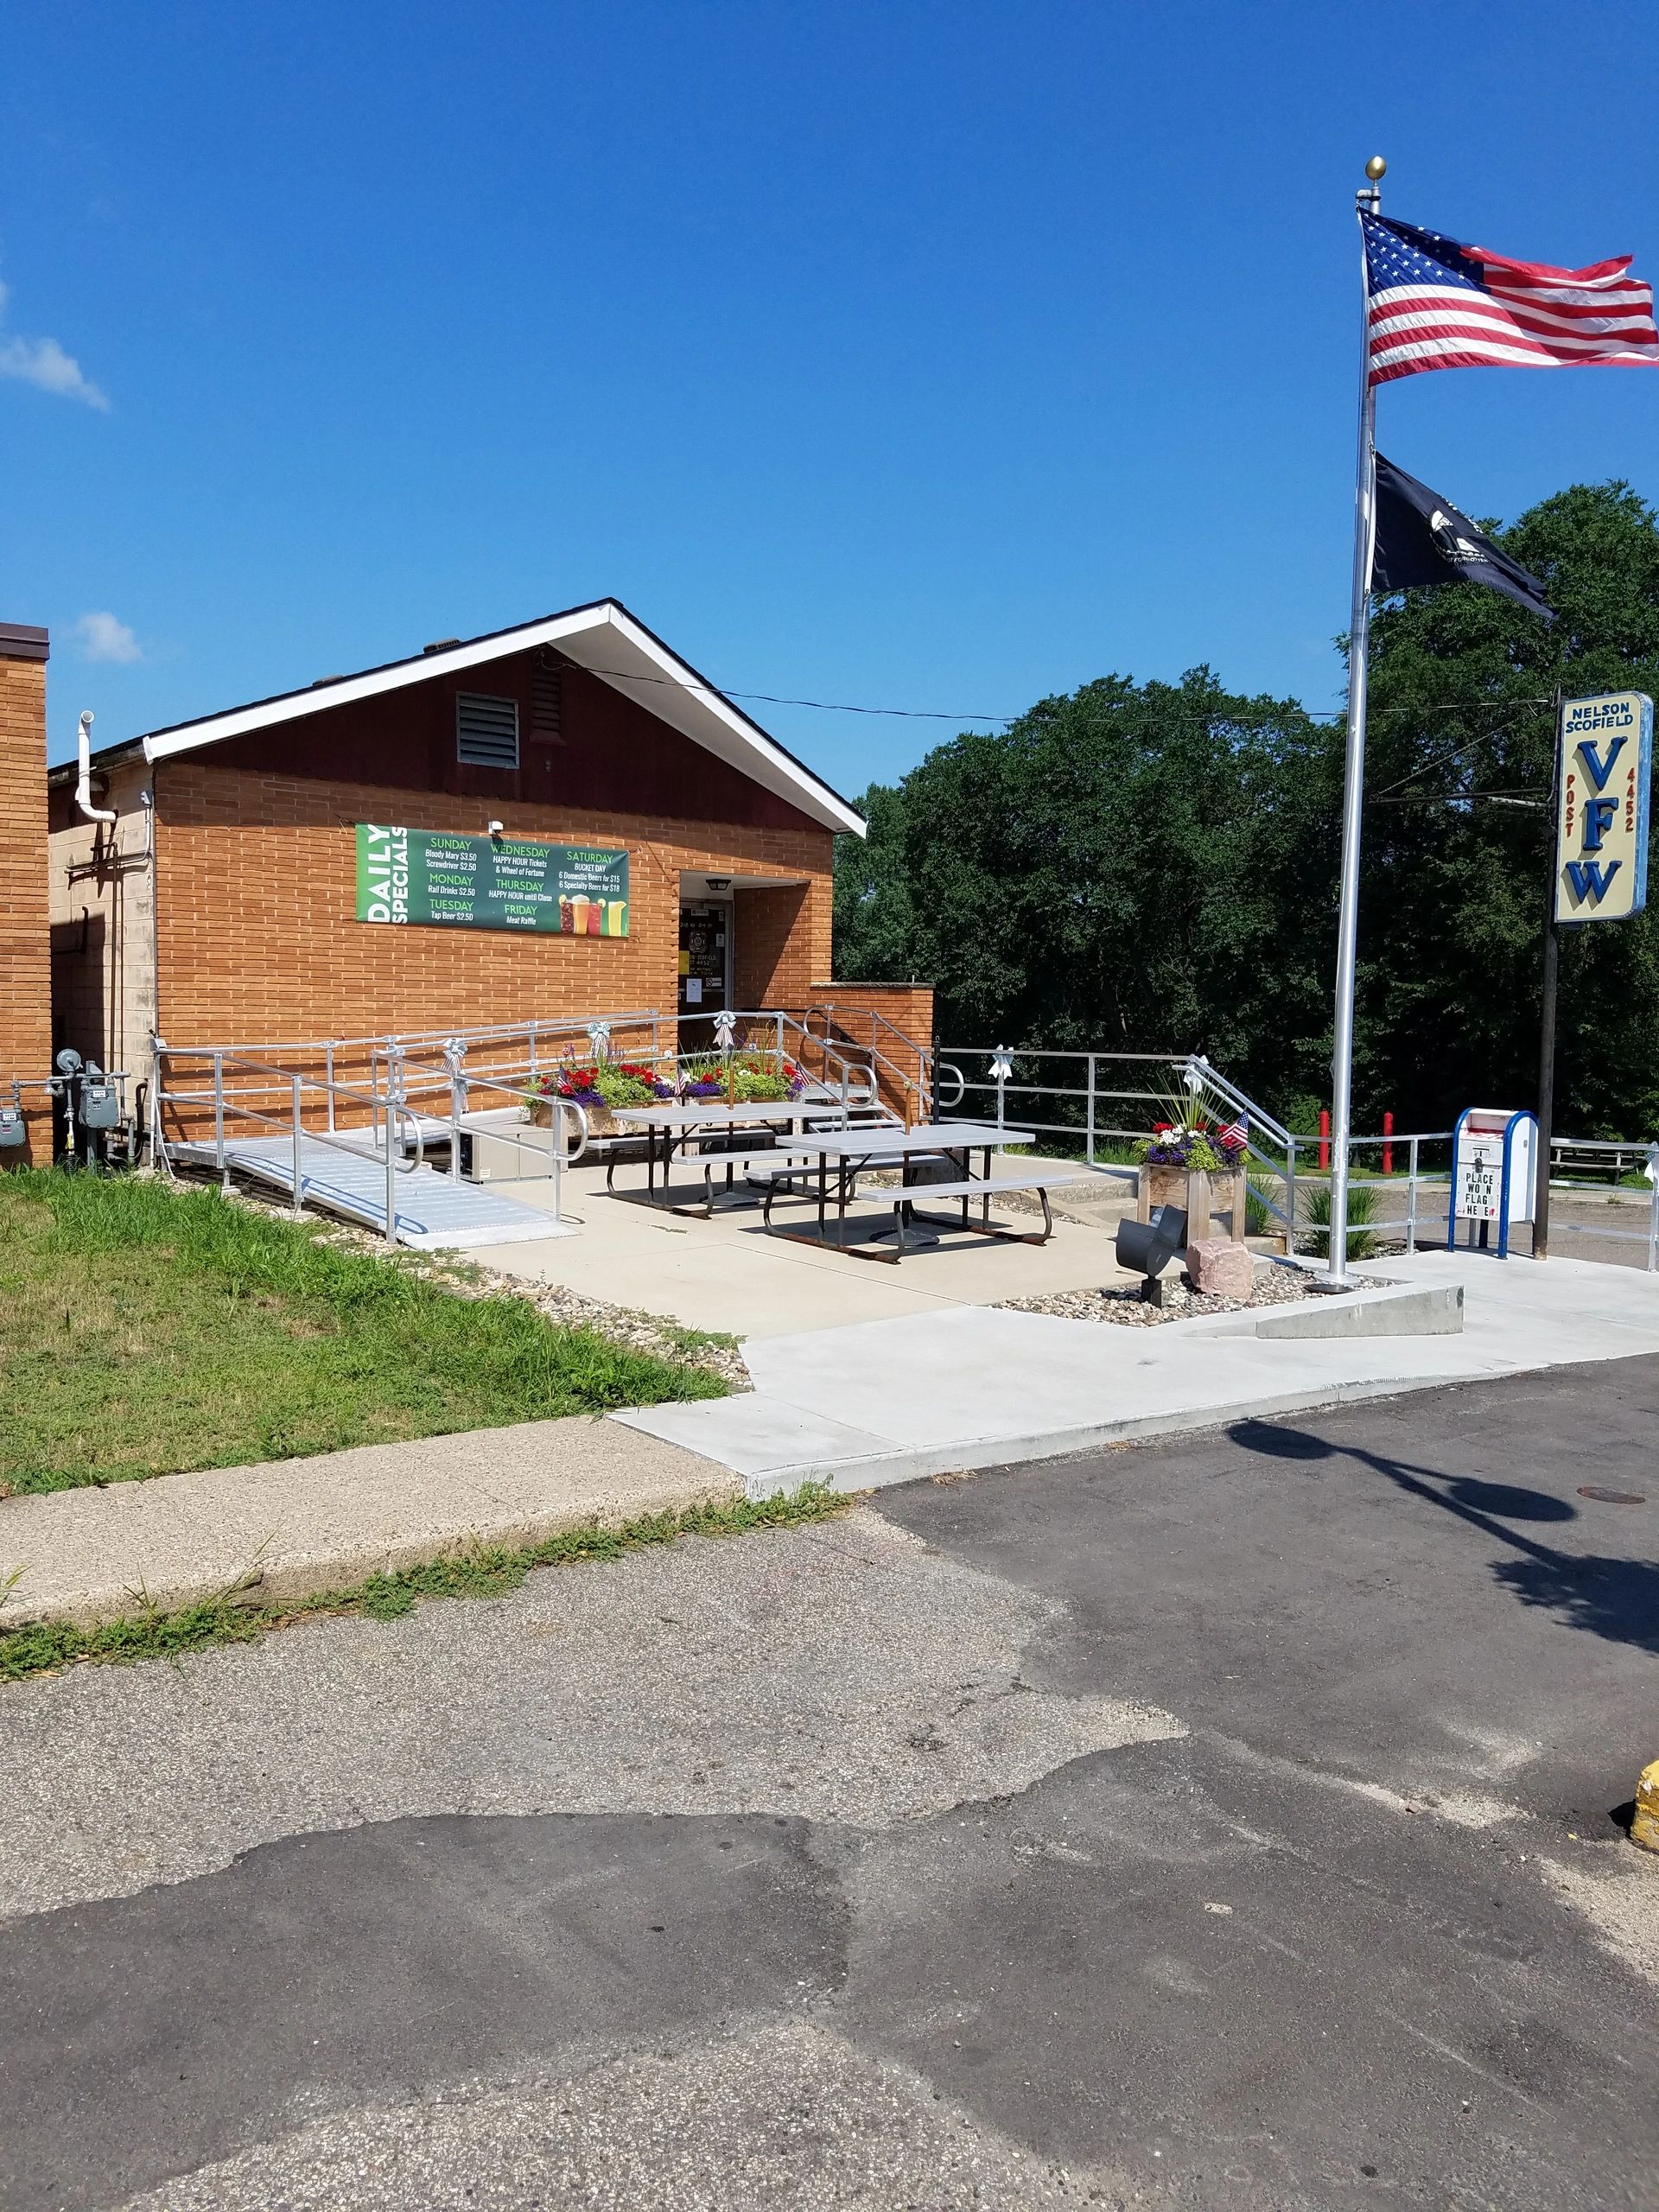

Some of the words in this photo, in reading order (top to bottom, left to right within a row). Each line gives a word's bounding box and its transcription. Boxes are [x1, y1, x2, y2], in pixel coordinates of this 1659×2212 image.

[1573, 702, 1630, 720] NELSON
[1565, 715, 1634, 734] SCOFIELD
[1565, 774, 1575, 838] POST
[1624, 766, 1636, 834] 4452
[430, 837, 472, 851] SUNDAY
[490, 842, 550, 858] WEDNESDAY
[425, 849, 444, 860] Bloody
[445, 850, 460, 861] Mary
[460, 852, 478, 861] $3.50
[566, 851, 613, 864] SATURDAY
[426, 859, 460, 870] Screwdriver
[460, 861, 477, 872] $2.50
[493, 855, 512, 864] HAPPY
[512, 857, 529, 866] HOUR
[529, 858, 547, 868] Tickets
[574, 862, 594, 873] BUCKET
[594, 864, 607, 873] DAY
[368, 824, 391, 922] DAILY
[391, 826, 409, 924] SPECIALS
[495, 865, 501, 874] &
[501, 866, 518, 875] Wheel
[525, 868, 545, 877] Fortune
[558, 871, 563, 880] 6
[563, 871, 588, 881] Domestic
[588, 873, 602, 881] Beers
[610, 874, 620, 883] $15
[429, 873, 474, 887] MONDAY
[496, 879, 544, 893] THURSDAY
[559, 880, 563, 889] 6
[563, 880, 588, 891] Specialty
[588, 882, 601, 891] Beers
[428, 885, 440, 894] Rail
[440, 886, 458, 895] Drinks
[459, 887, 475, 897] $2.50
[488, 890, 507, 899] HAPPY
[507, 891, 524, 900] HOUR
[524, 893, 537, 901] until
[537, 893, 553, 902] Close
[429, 899, 474, 912] TUESDAY
[505, 904, 538, 916] FRIDAY
[431, 910, 442, 920] Tap
[442, 912, 455, 920] Beer
[456, 912, 474, 922] $2.50
[506, 915, 520, 925] Meat
[520, 917, 537, 925] Raffle
[1466, 1173, 1493, 1184] PLACE
[1468, 1184, 1491, 1194] WON
[1465, 1193, 1487, 1205] FLAG
[1467, 1205, 1488, 1216] HEE
